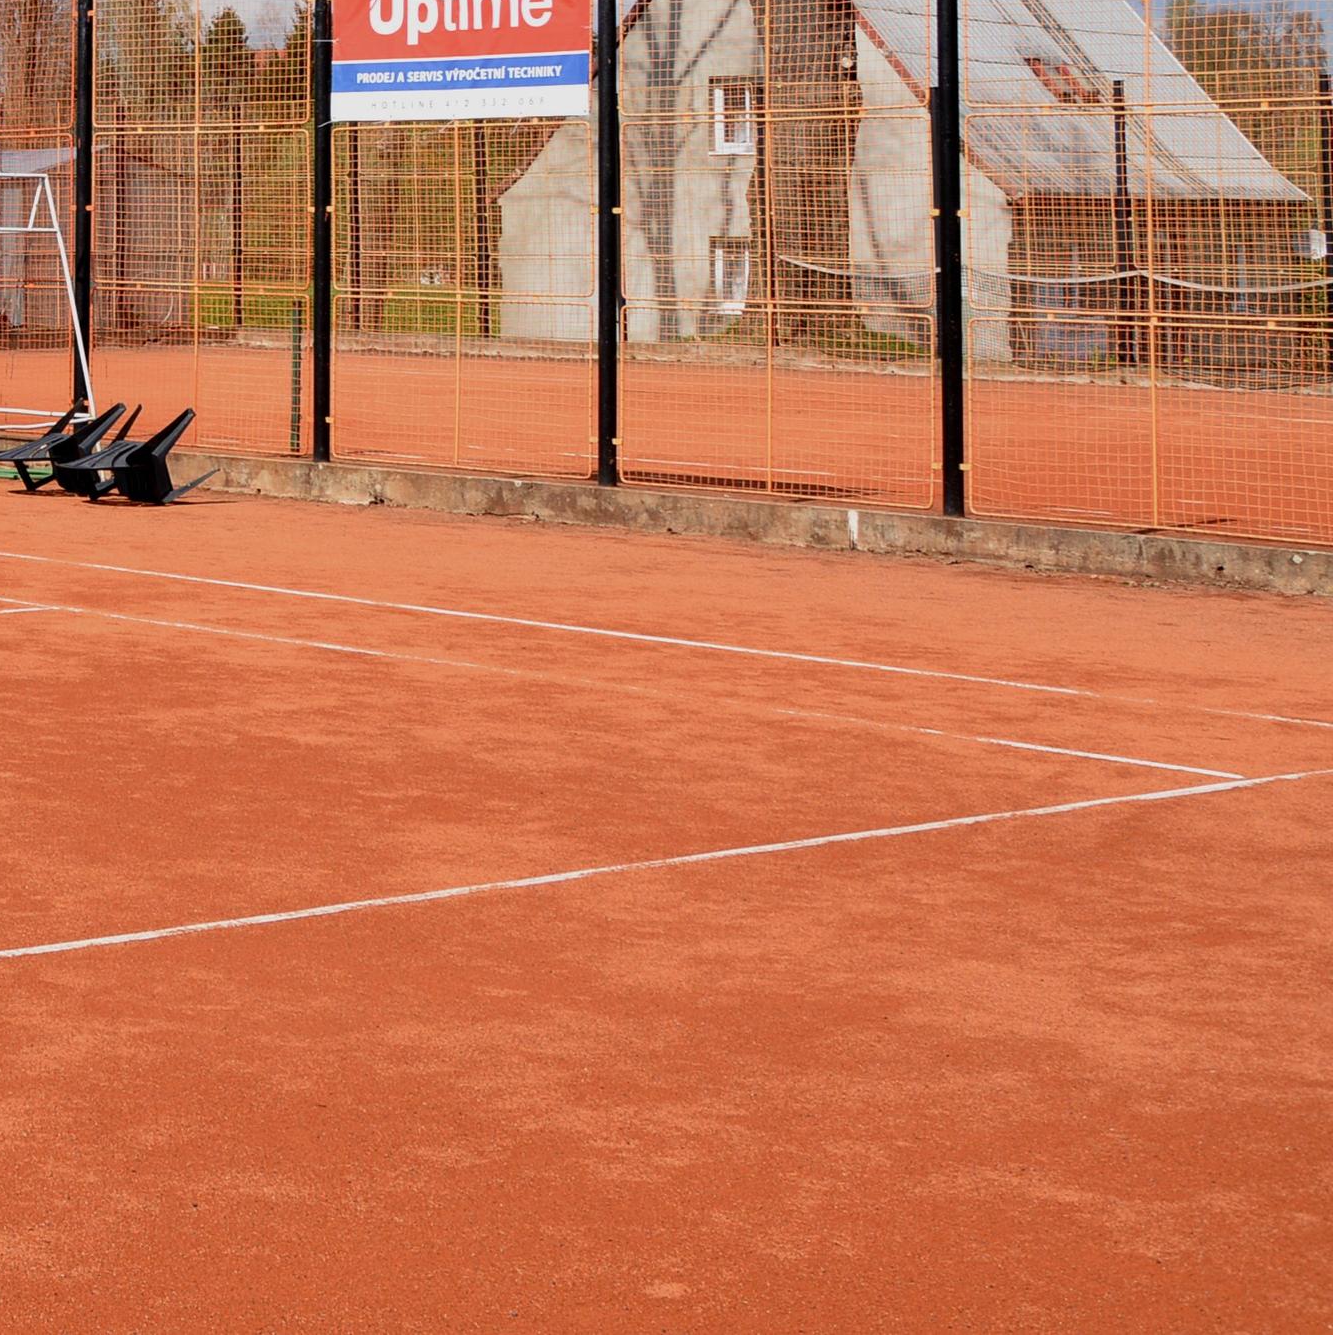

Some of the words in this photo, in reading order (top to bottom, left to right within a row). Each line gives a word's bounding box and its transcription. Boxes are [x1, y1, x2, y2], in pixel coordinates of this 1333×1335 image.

[357, 72, 395, 84] PRODEJ
[397, 72, 405, 83] A
[407, 69, 443, 83] SERVIS
[445, 65, 506, 82] VÝPOČETNÍ
[508, 64, 563, 79] TECHNIKY
[371, 99, 435, 111] HOTLINE
